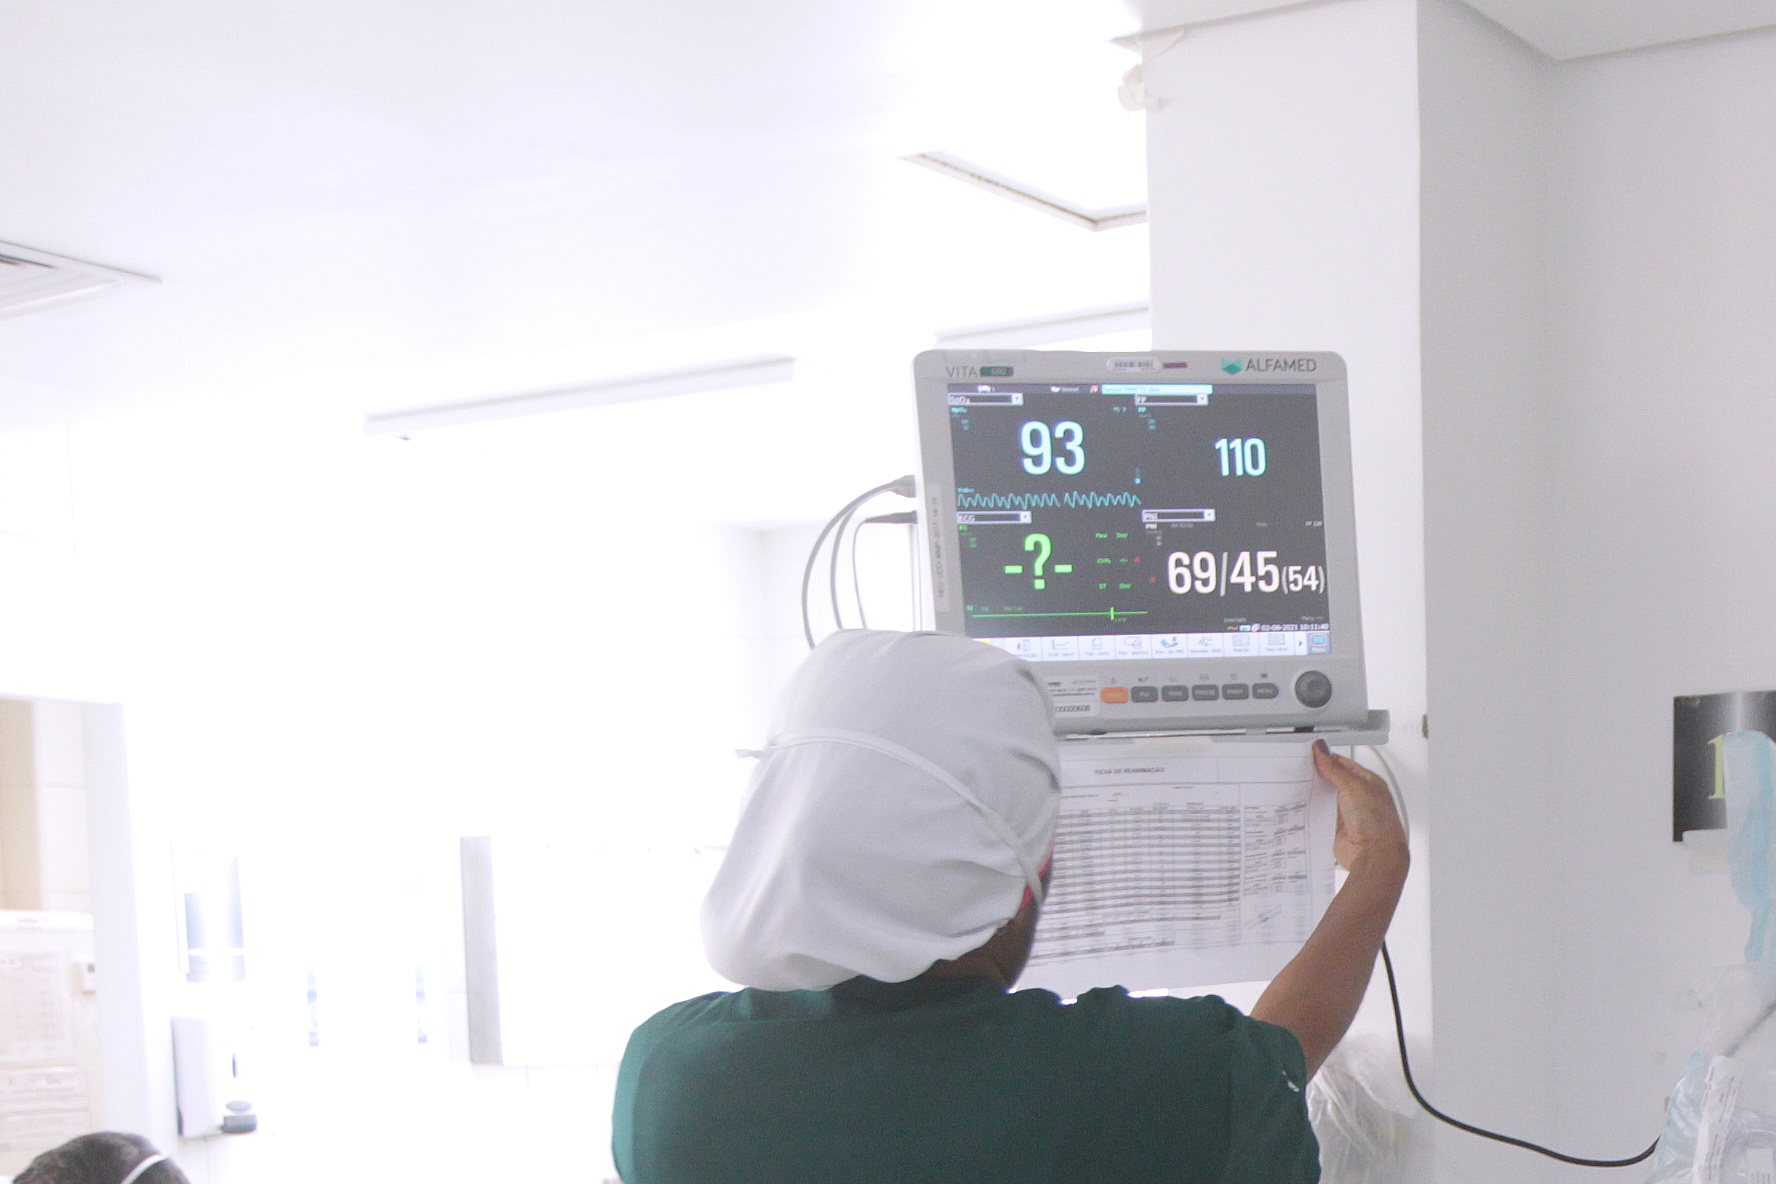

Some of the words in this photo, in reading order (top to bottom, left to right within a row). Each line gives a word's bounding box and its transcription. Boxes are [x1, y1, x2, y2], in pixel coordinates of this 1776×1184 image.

[946, 366, 977, 378] VITA
[1246, 358, 1317, 372] ALFAMED
[1020, 421, 1085, 475] 93
[1214, 437, 1266, 477] 110
